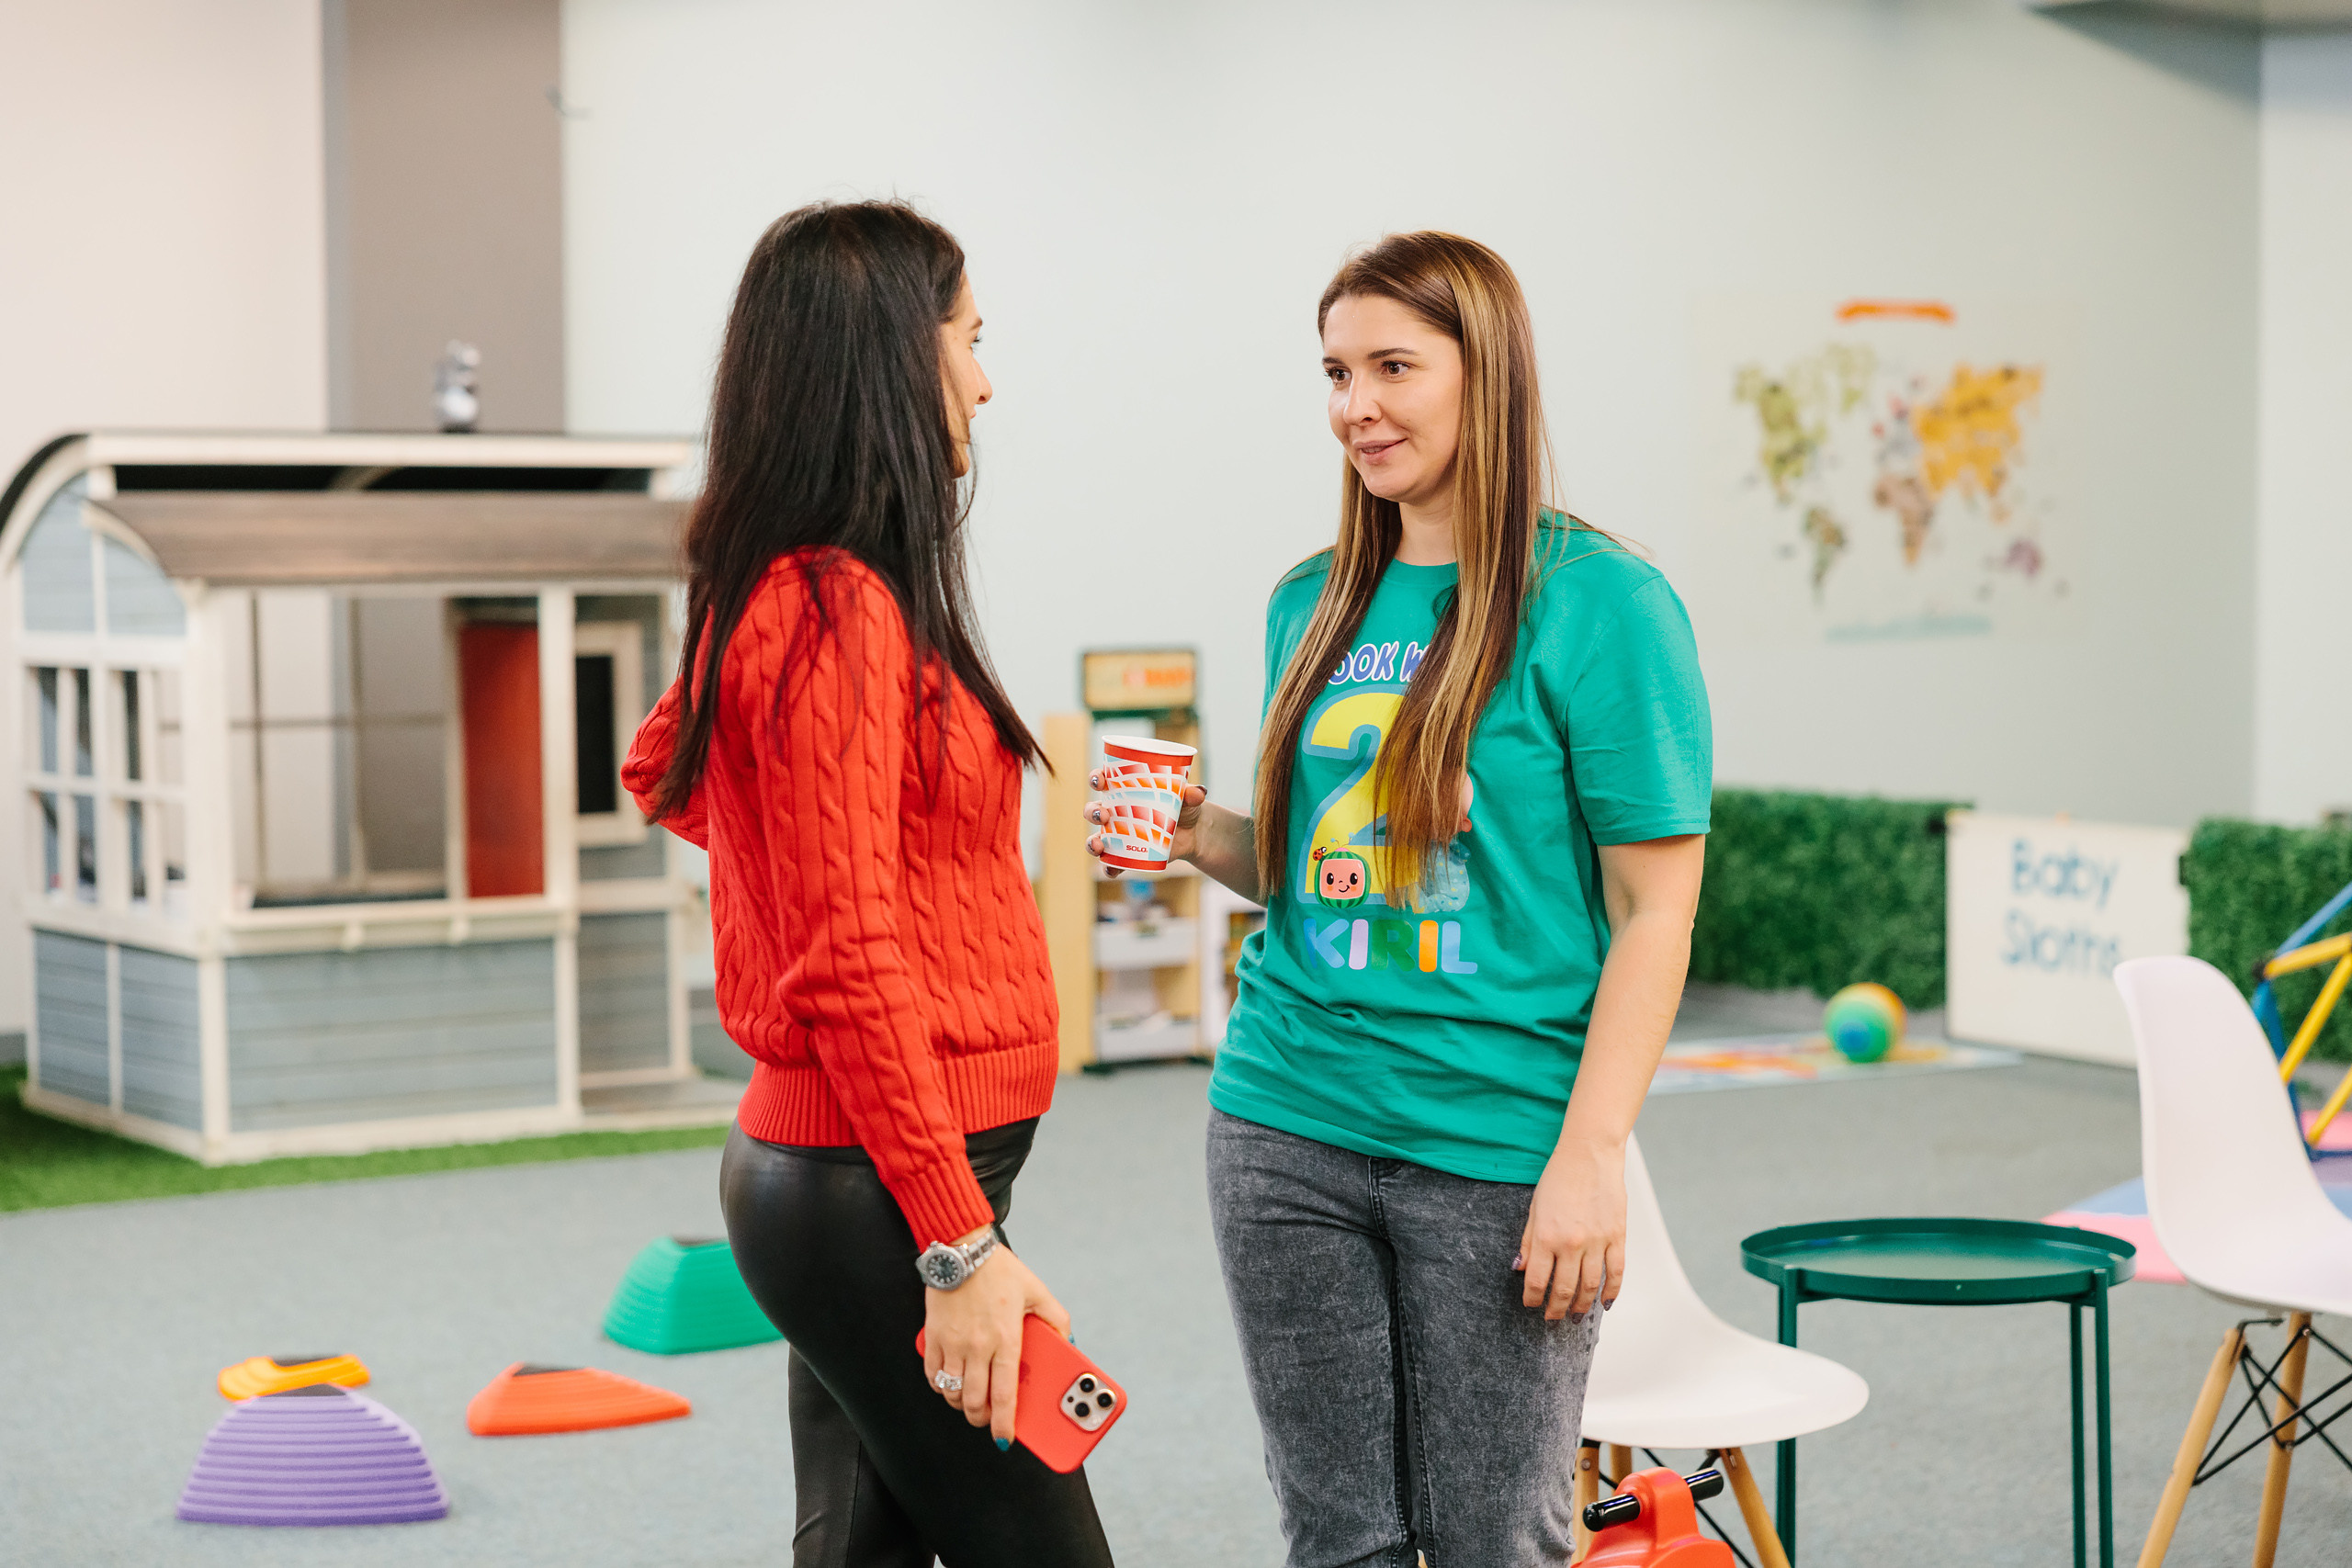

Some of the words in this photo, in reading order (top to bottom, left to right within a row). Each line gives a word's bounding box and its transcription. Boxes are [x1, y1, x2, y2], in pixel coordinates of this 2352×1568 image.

[1125, 844, 1148, 853] SOLO
[2010, 837, 2117, 910] Baby
[1303, 918, 1478, 975] KIRIL
